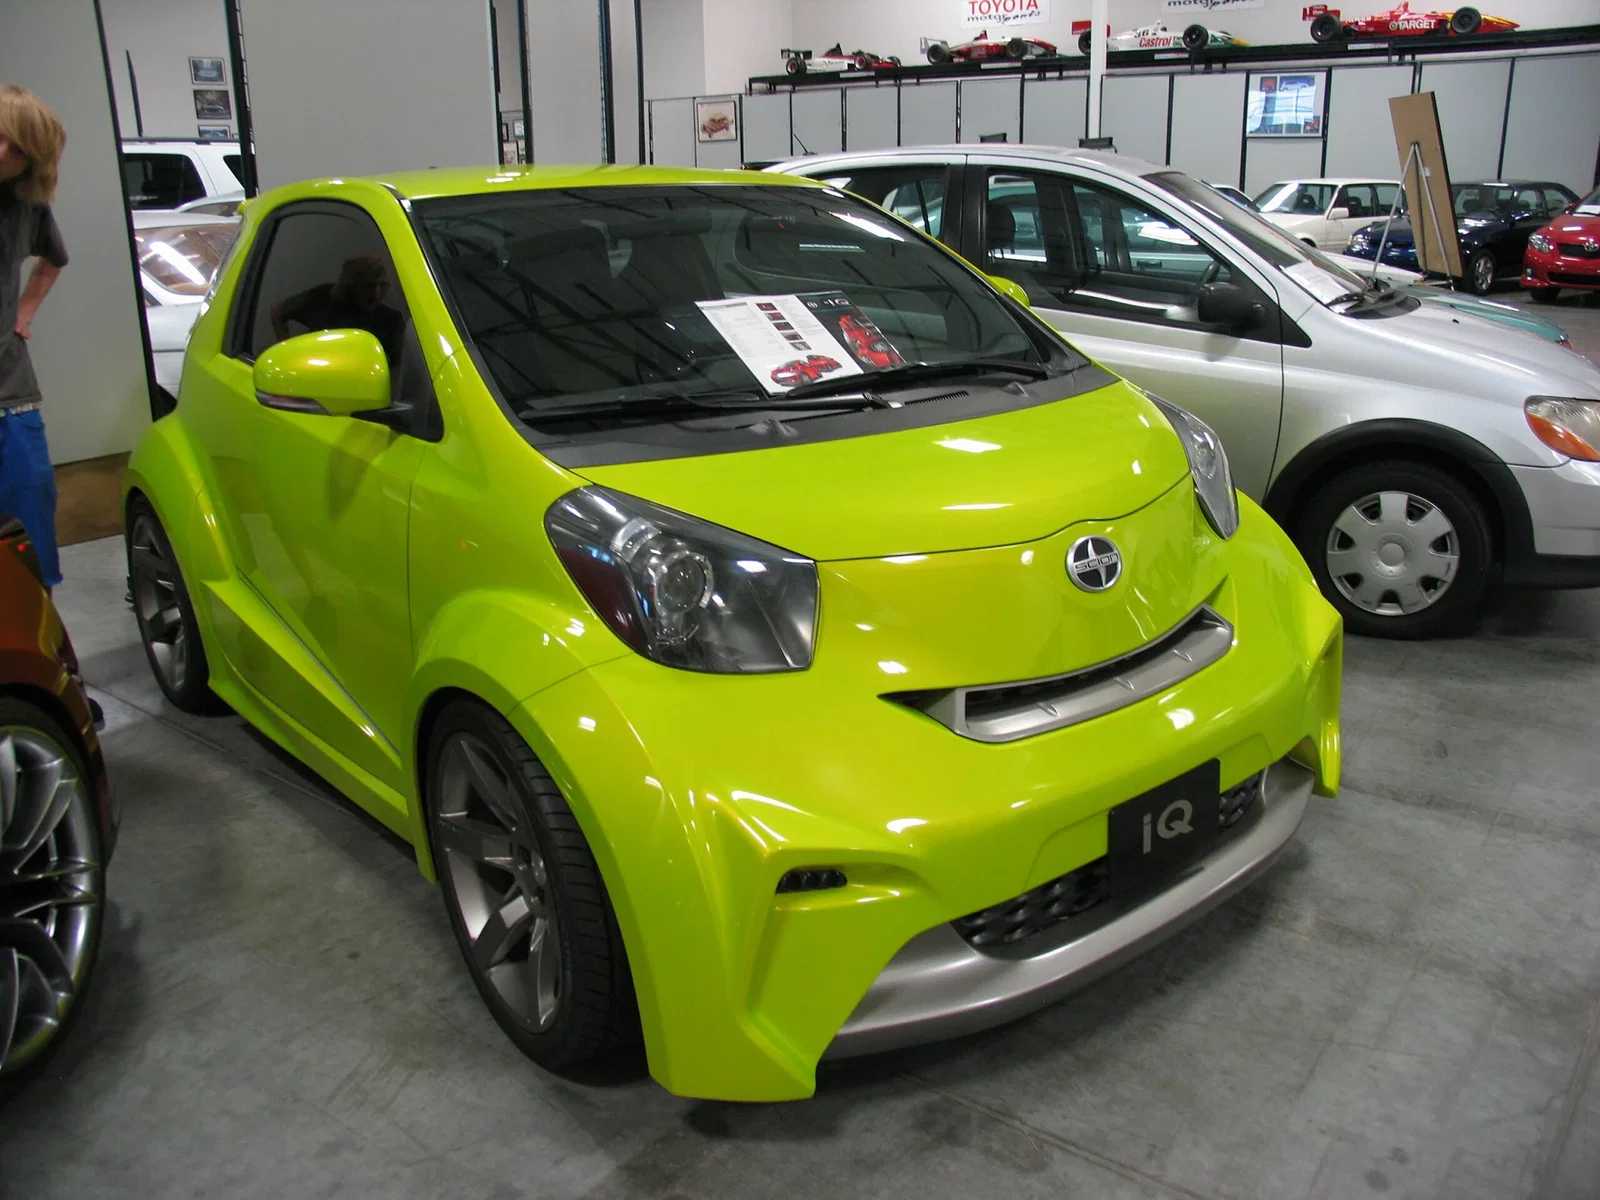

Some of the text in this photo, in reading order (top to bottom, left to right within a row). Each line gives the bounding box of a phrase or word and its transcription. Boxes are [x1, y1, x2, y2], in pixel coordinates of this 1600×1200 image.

[968, 0, 1039, 15] TOYOTA
[1397, 19, 1436, 30] TARGET
[1139, 36, 1172, 48] Castrol
[1143, 799, 1194, 854] iQ
